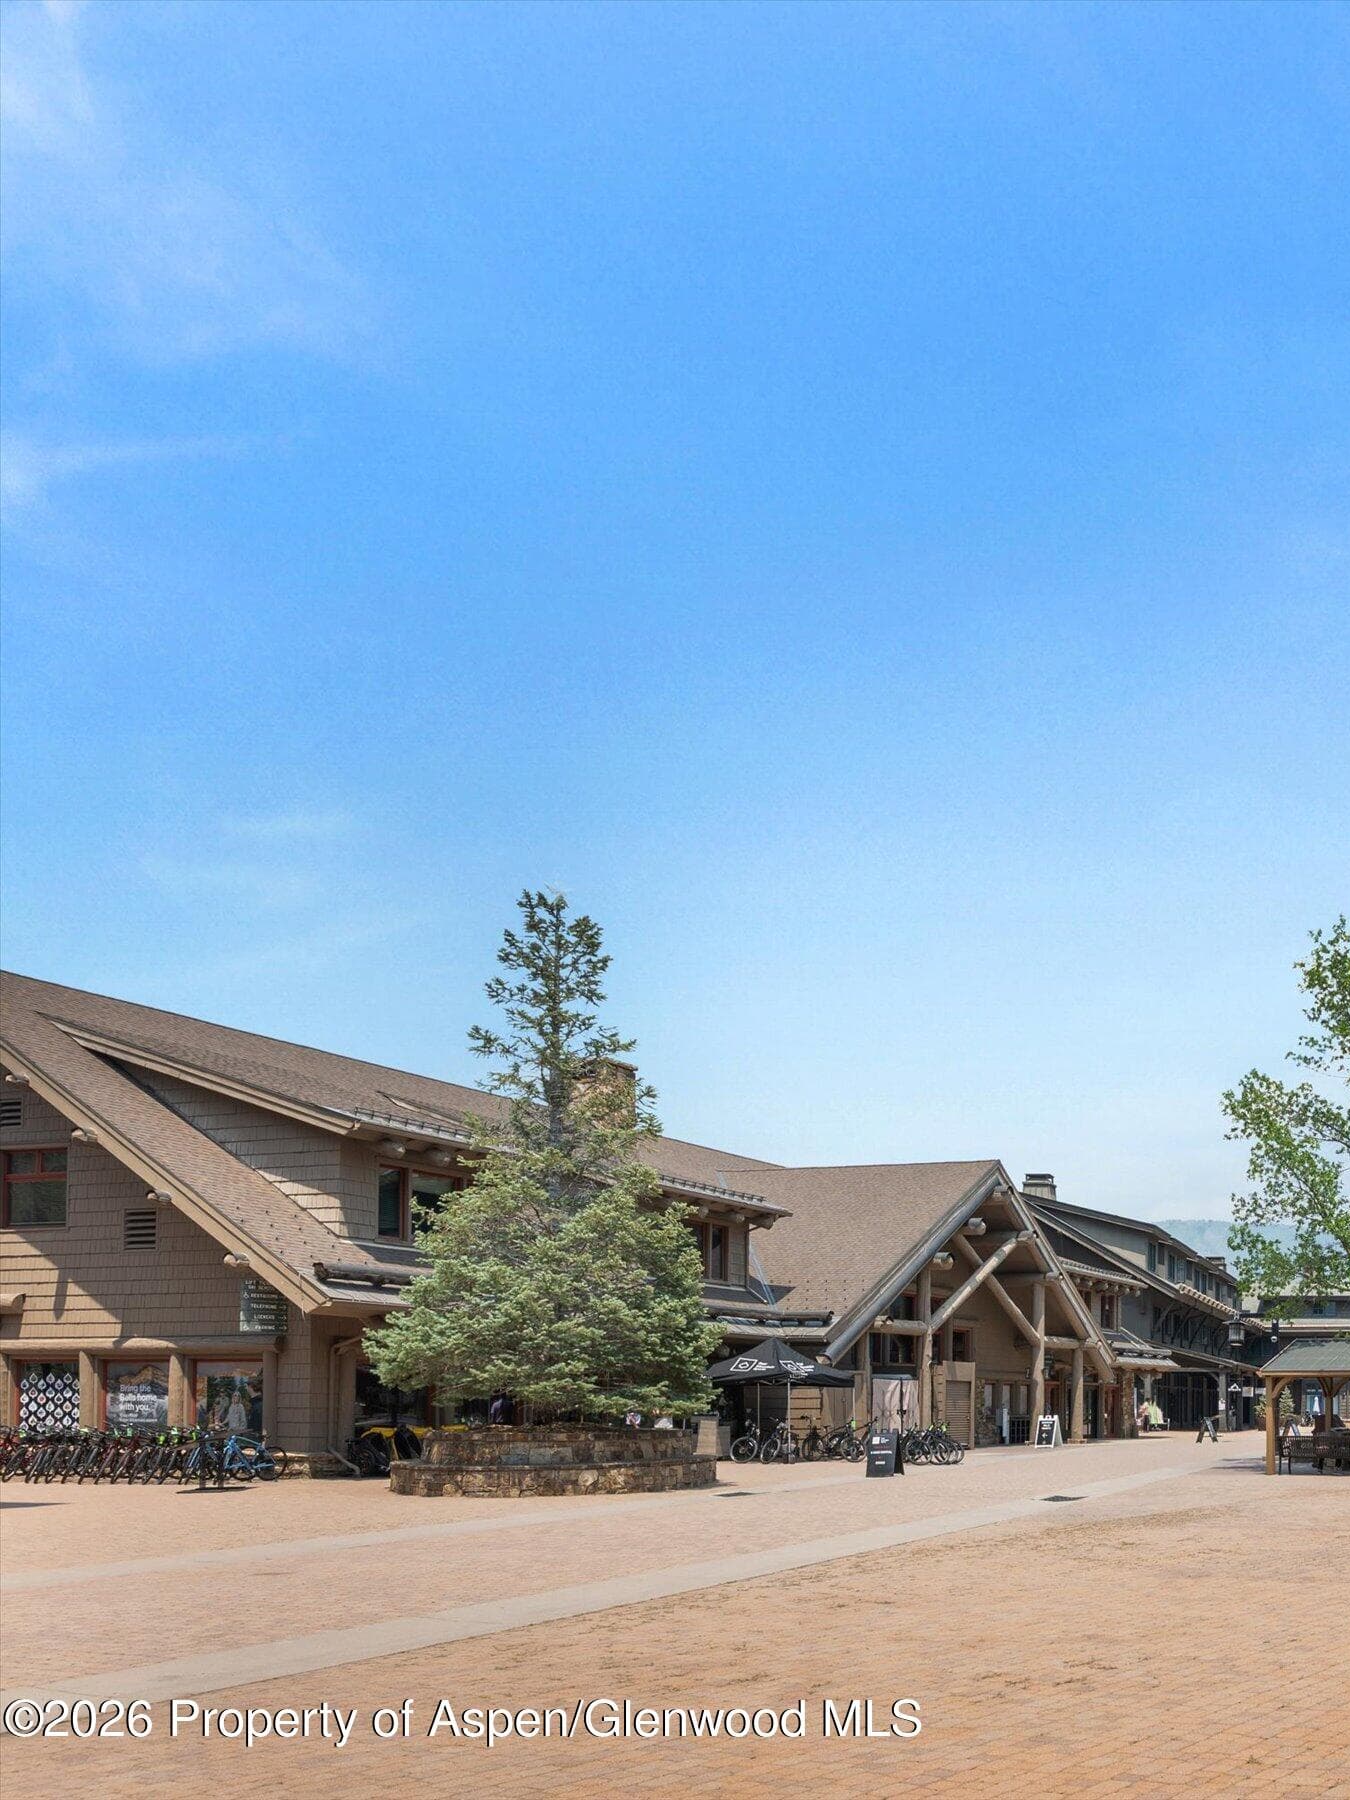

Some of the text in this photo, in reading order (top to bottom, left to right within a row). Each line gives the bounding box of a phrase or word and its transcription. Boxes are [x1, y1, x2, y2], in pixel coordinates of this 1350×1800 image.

[120, 1384, 138, 1393] Bring
[137, 1393, 157, 1401] home
[119, 1403, 134, 1411] with
